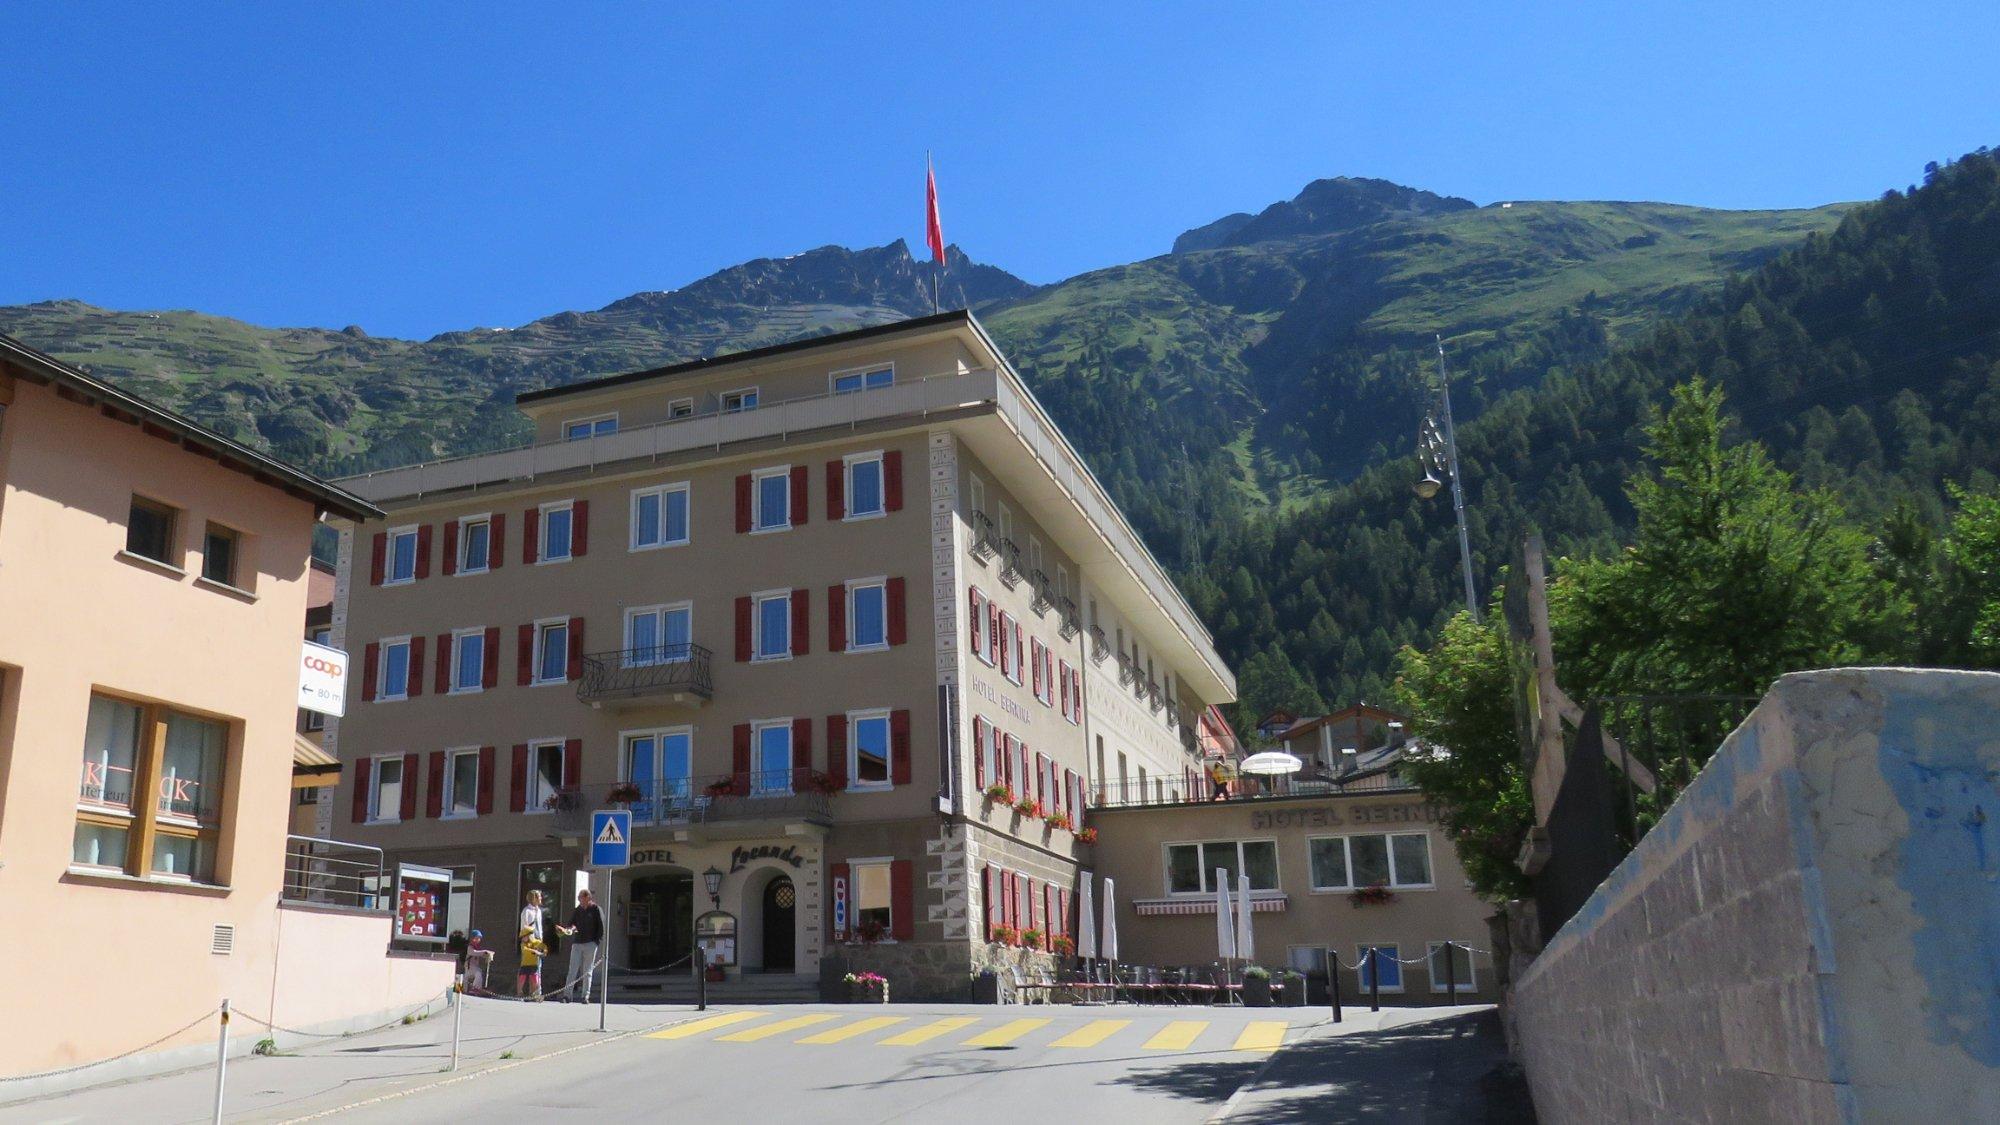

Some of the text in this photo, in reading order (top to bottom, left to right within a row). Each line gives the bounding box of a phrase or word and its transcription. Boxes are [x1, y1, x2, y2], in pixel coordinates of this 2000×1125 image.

[304, 655, 343, 678] coop
[317, 689, 341, 702] 80 m
[972, 673, 1031, 725] HOTEL BERNINA
[1250, 806, 1343, 830] HOTEL
[630, 849, 676, 864] OTEL
